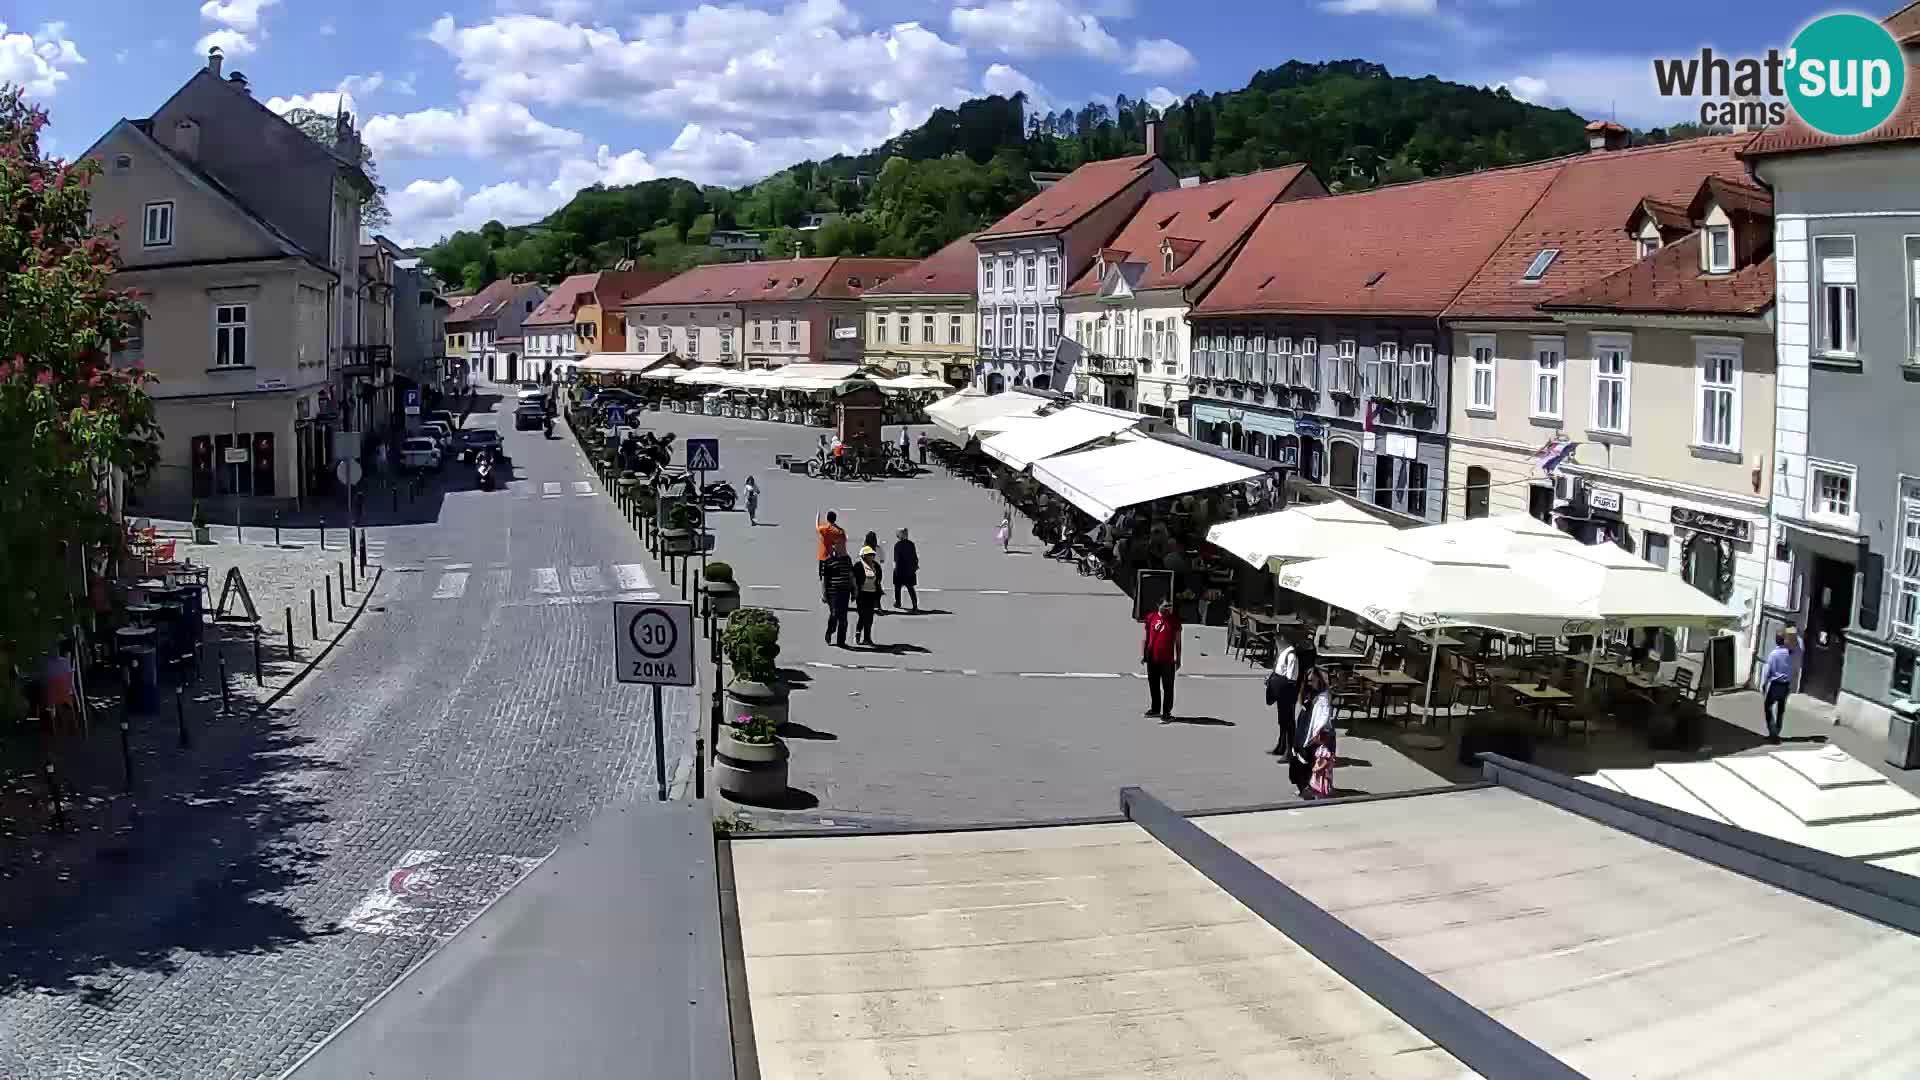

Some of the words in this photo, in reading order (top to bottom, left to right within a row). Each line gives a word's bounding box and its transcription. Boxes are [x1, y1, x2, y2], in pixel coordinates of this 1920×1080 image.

[408, 392, 416, 404] P
[641, 624, 666, 645] 30
[632, 661, 677, 678] ZONA
